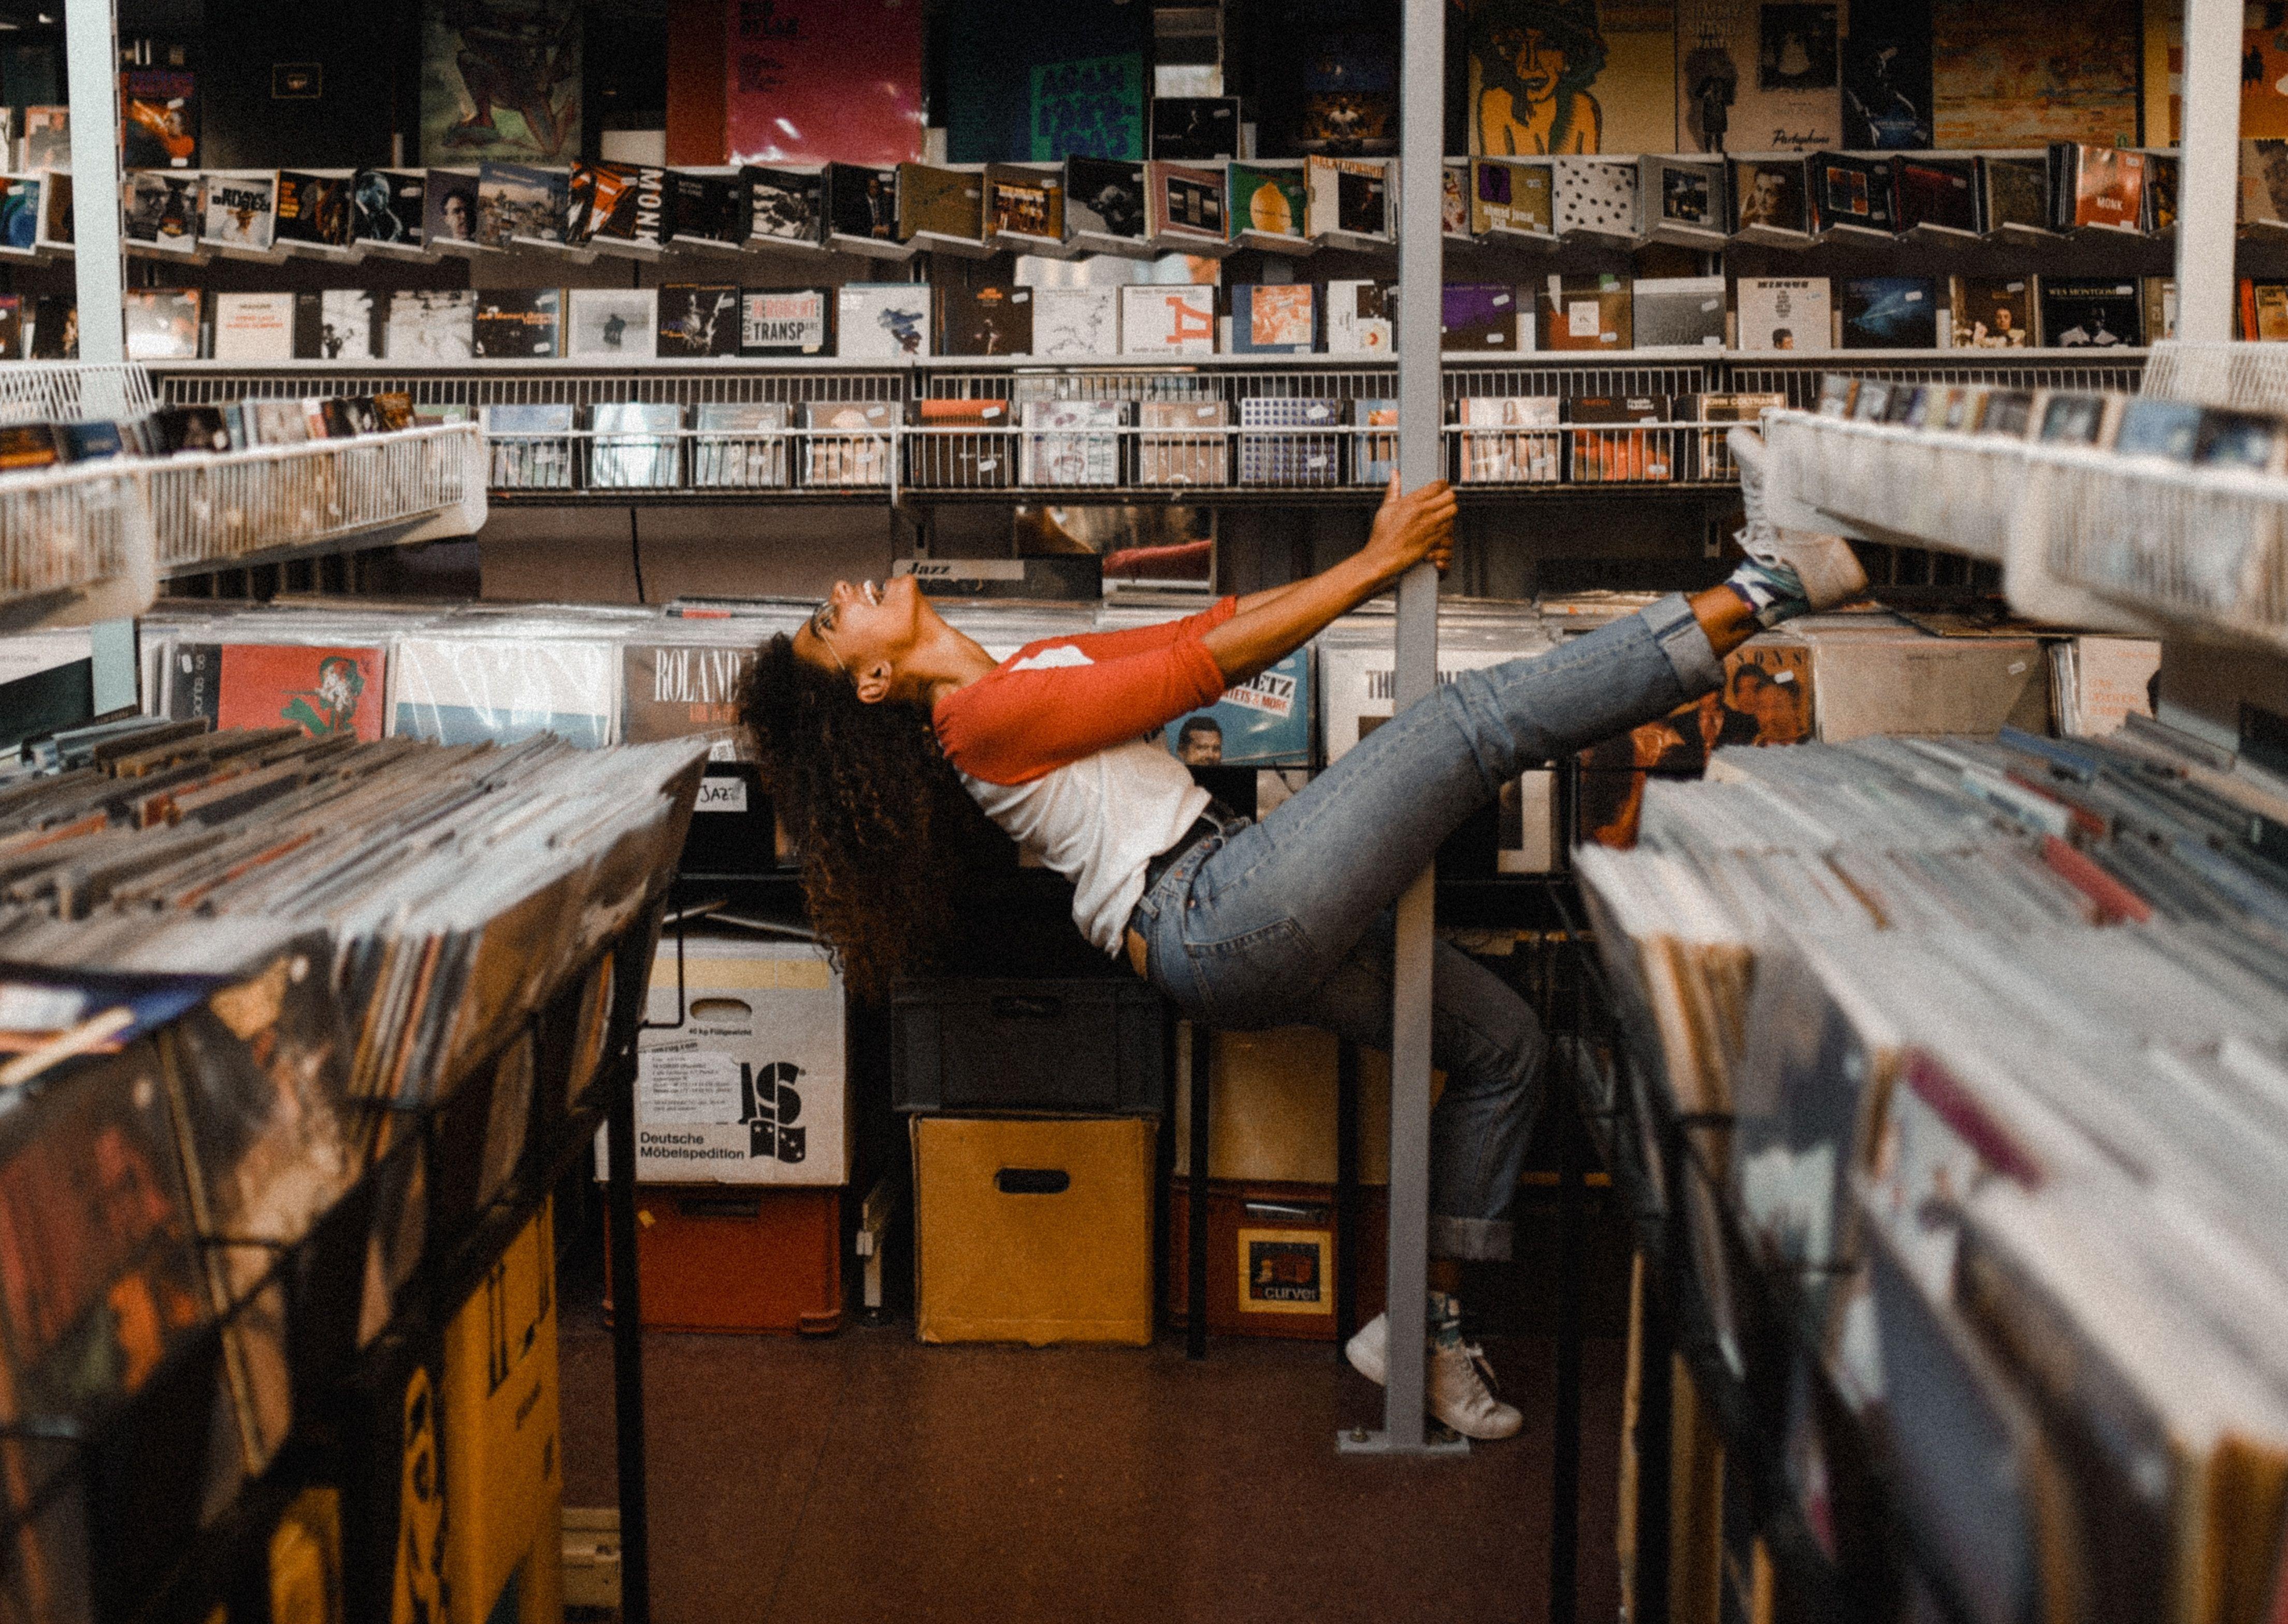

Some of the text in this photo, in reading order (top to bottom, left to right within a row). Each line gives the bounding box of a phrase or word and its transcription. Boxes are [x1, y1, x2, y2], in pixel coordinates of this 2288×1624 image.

[635, 169, 665, 240] MONK
[2097, 197, 2123, 211] MONK
[2070, 288, 2133, 297] MONTGOM
[906, 562, 951, 575] Jazz
[654, 648, 741, 703] ROLAND
[1261, 695, 1288, 711] MORE
[640, 1132, 704, 1145] Deutsche
[640, 1145, 745, 1161] Möbelspedition
[1264, 1287, 1318, 1300] curver
